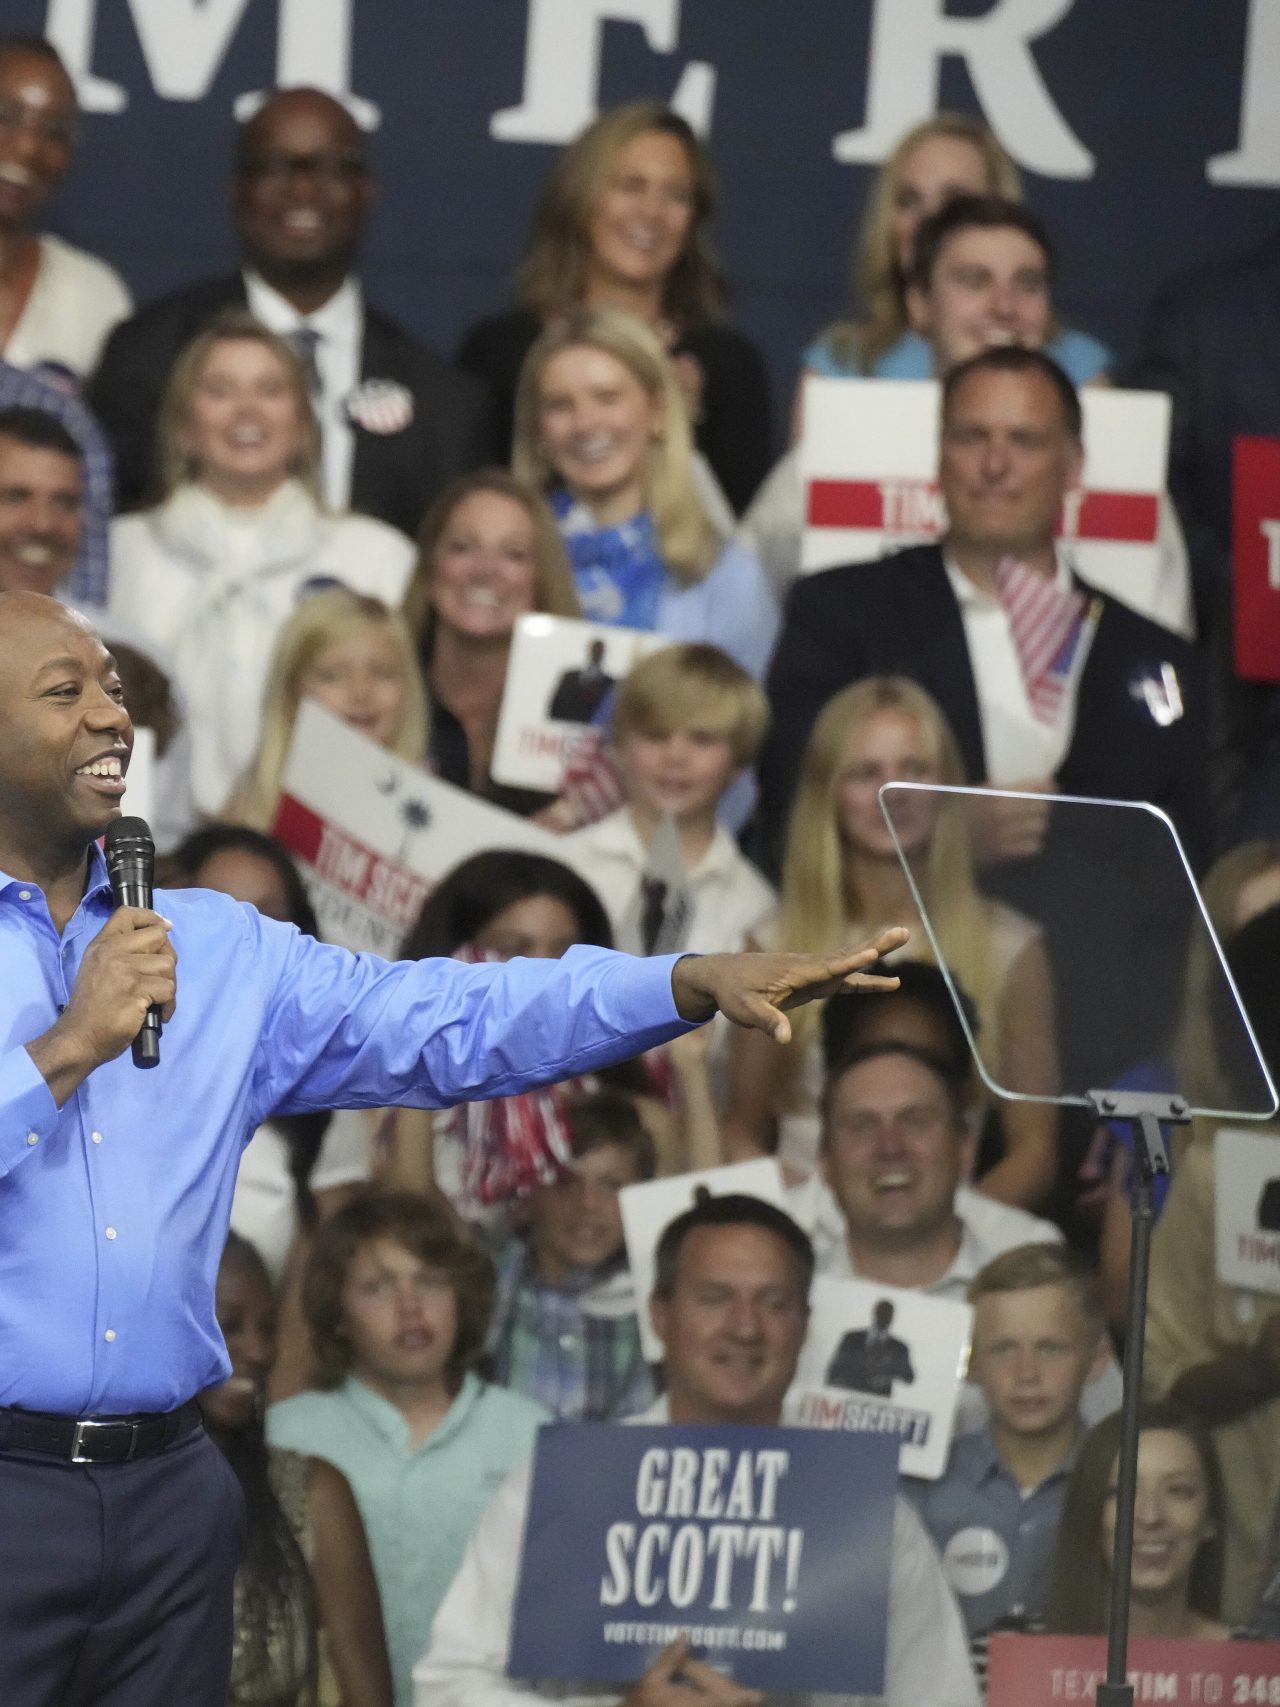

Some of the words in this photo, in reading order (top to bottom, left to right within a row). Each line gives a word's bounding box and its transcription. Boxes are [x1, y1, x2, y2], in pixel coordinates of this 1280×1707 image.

[635, 1447, 790, 1520] GREAT
[600, 1522, 805, 1614] SCOTT!
[1126, 1670, 1179, 1703] TIM
[1188, 1672, 1223, 1705] TO
